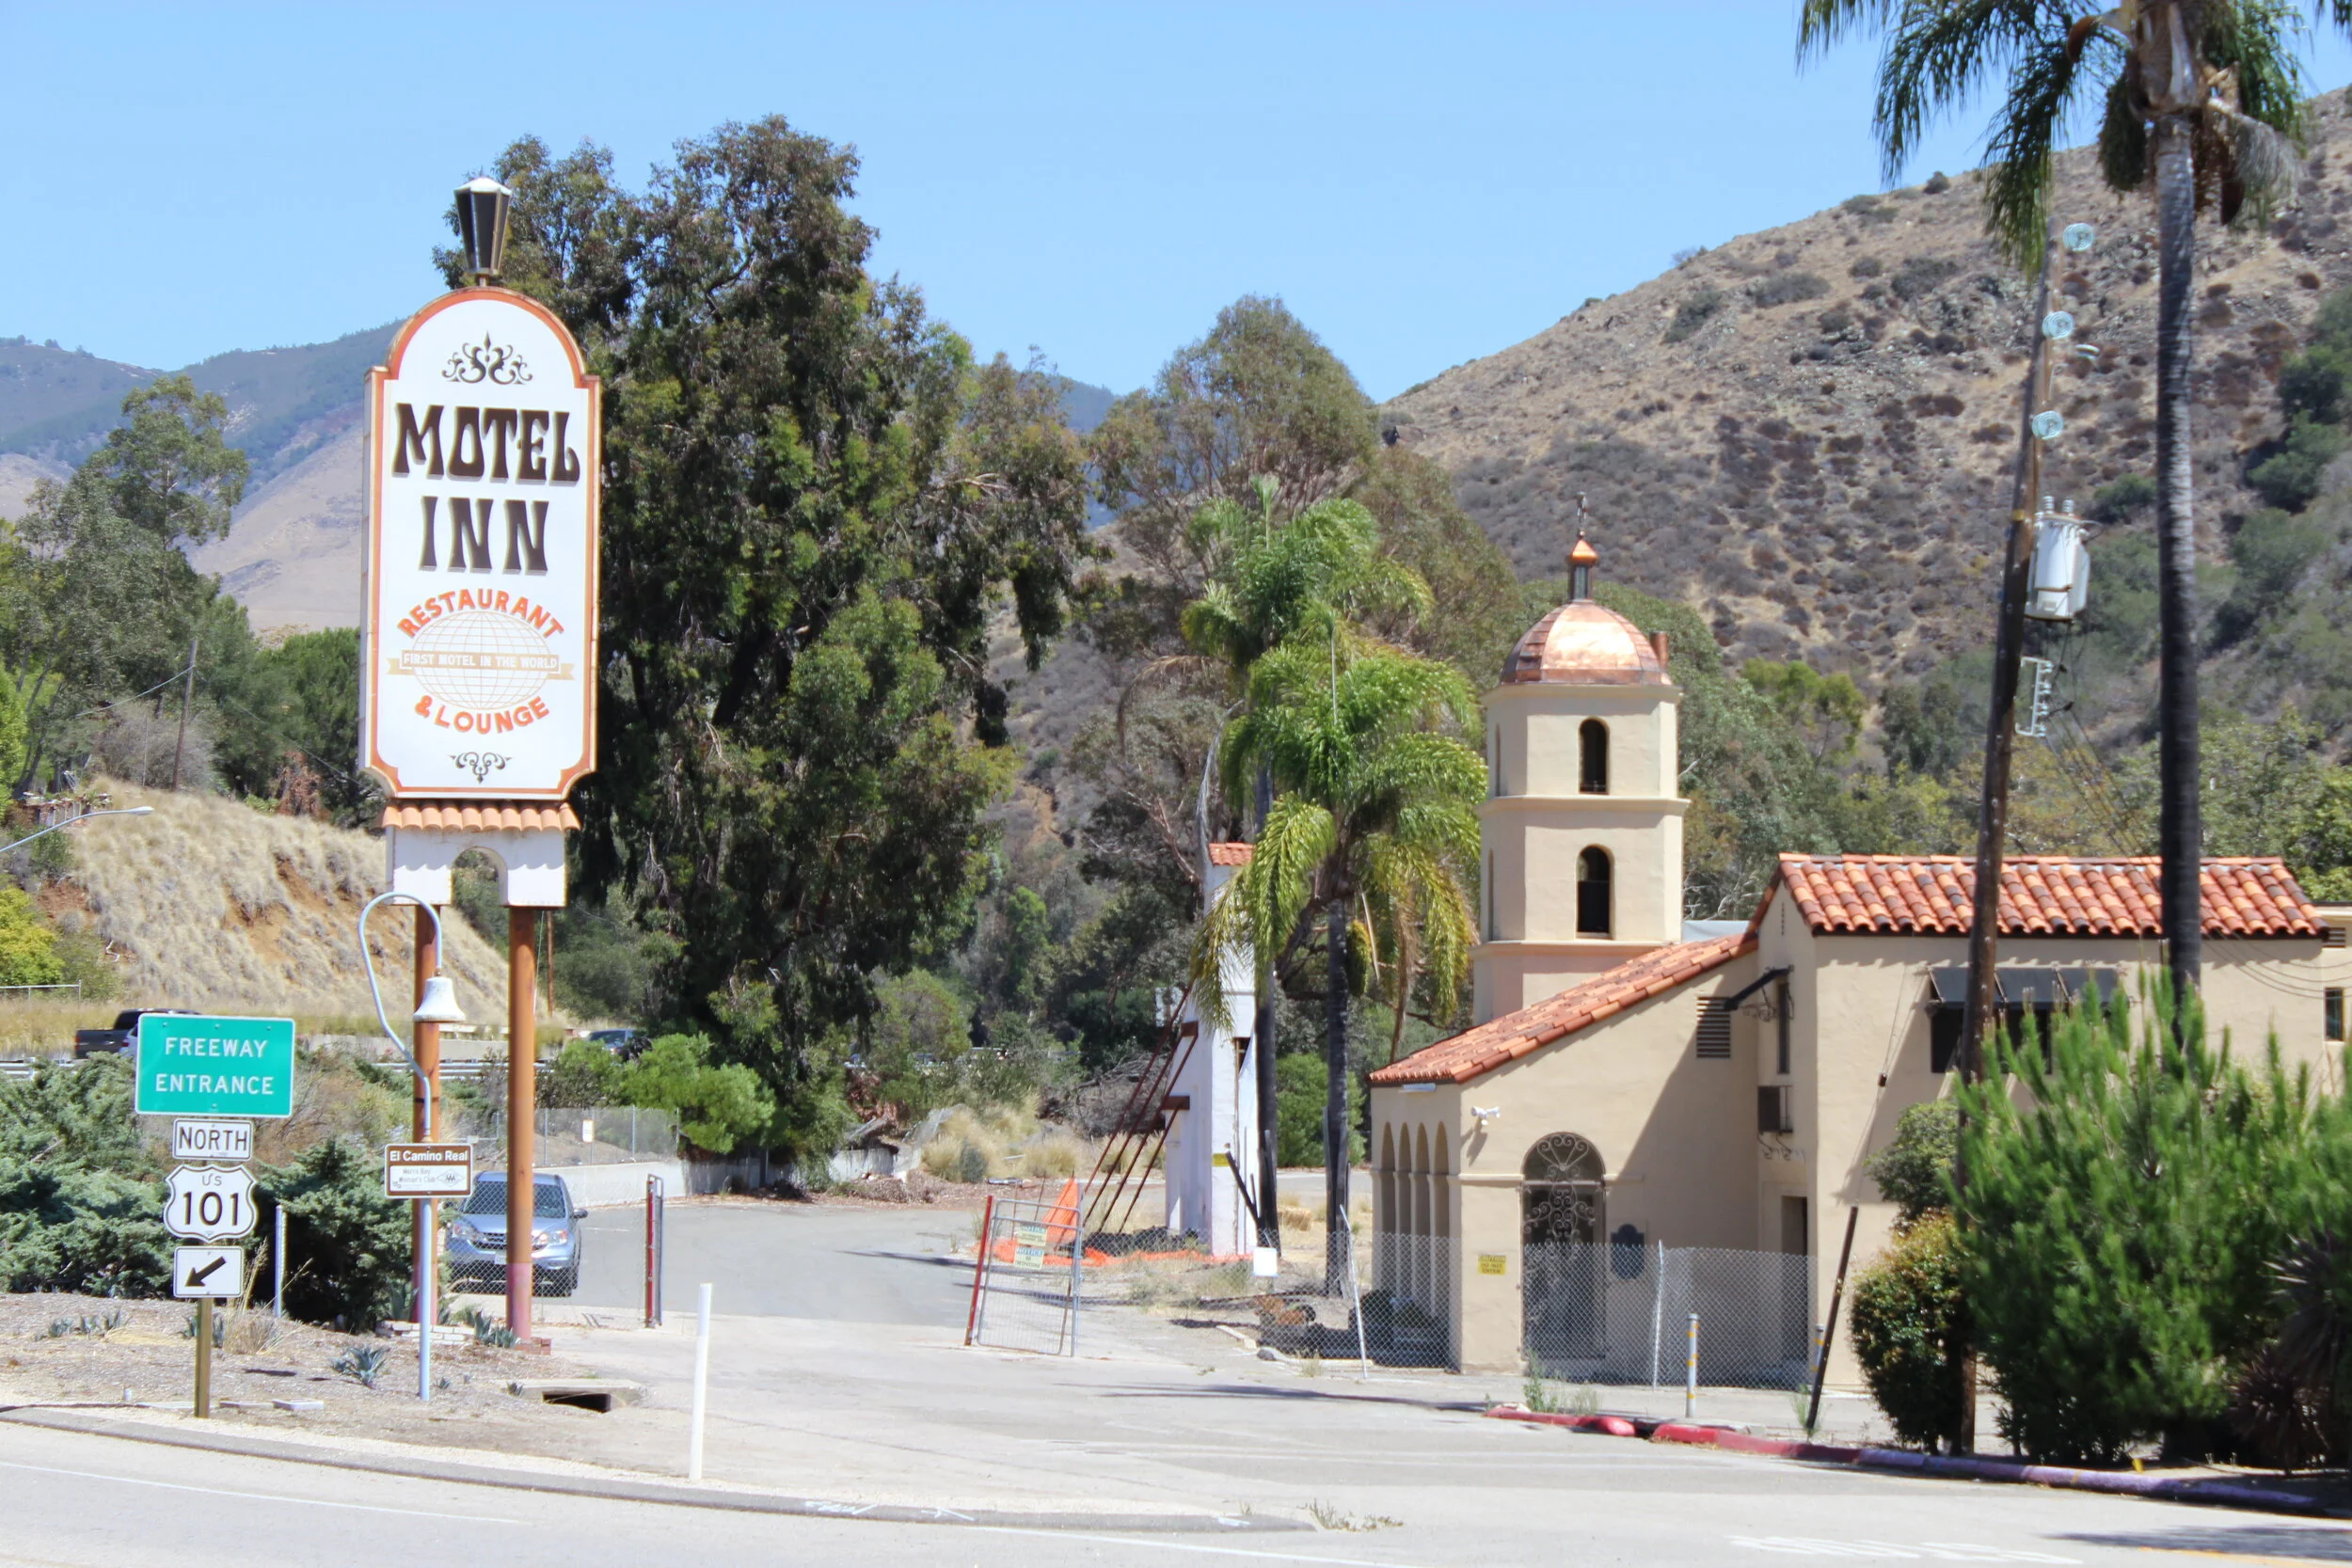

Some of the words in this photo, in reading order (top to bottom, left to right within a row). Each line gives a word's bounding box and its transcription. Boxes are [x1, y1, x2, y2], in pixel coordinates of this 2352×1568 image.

[391, 403, 580, 487] MOTEL
[419, 496, 549, 576] INN
[397, 588, 564, 640] RESTAURANT
[404, 653, 435, 665] FIRST
[438, 654, 476, 666] MOTEL
[480, 656, 491, 667] IN
[496, 657, 516, 668] THE
[520, 657, 558, 669] WORLD
[414, 695, 433, 718] &
[434, 696, 550, 735] LOUNGE
[165, 1037, 268, 1058] FREEWAY
[155, 1073, 275, 1095] ENTRANCE
[178, 1127, 247, 1151] NORTH
[389, 1150, 400, 1162] El
[403, 1150, 442, 1162] Camino
[444, 1150, 468, 1162] Real
[201, 1175, 222, 1186] US
[183, 1191, 239, 1226] 101
